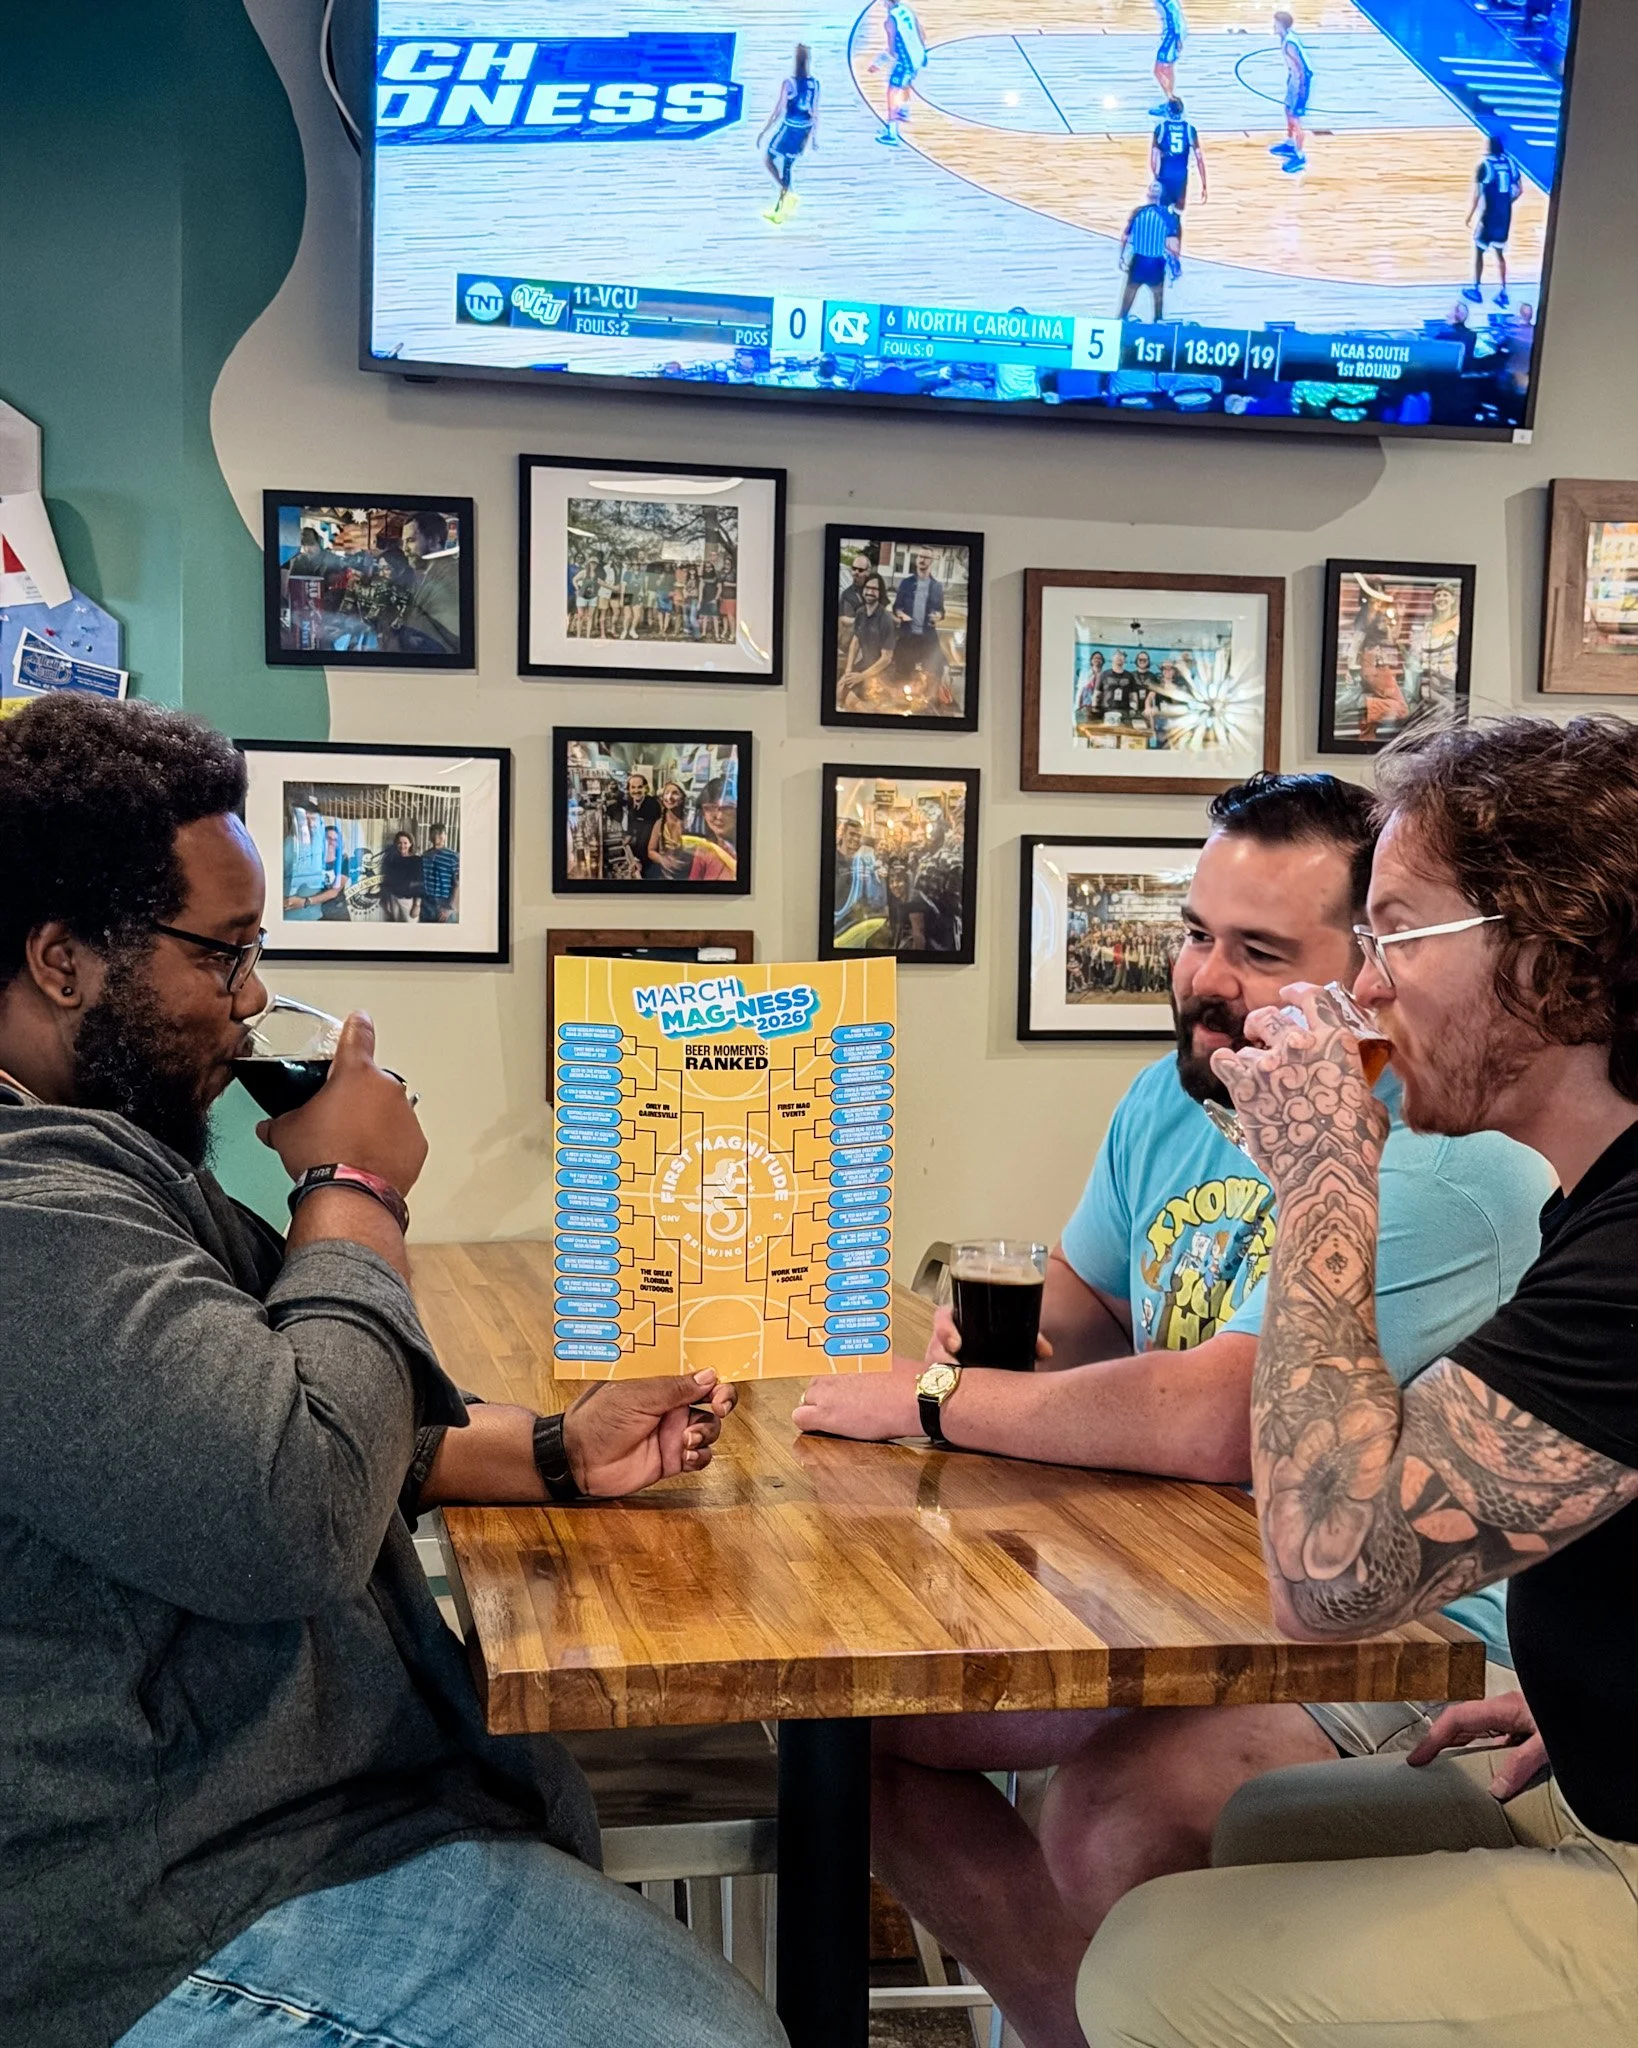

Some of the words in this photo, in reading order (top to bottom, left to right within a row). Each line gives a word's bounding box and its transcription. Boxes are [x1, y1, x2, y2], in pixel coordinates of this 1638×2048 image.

[378, 42, 539, 81] CH
[1170, 131, 1184, 154] 5
[465, 293, 504, 311] TNT
[573, 286, 639, 311] 11-VCU
[575, 317, 630, 337] FOULS:2
[789, 307, 807, 340] 0
[886, 310, 897, 327] 6
[906, 310, 968, 334] NORTH
[973, 314, 1065, 340] CAROLINA
[734, 329, 769, 346] POSS
[1087, 328, 1106, 360] 5
[883, 340, 935, 358] FOULS:0
[1134, 337, 1165, 363] 1ST
[1184, 338, 1241, 367] 18:09
[1250, 346, 1276, 370] 19
[1330, 342, 1365, 360] NCAA
[1366, 344, 1410, 362] SOUTH
[1355, 361, 1402, 380] ROUND
[636, 978, 736, 1009] MARCH
[661, 987, 811, 1031] MAG-NESS
[756, 1010, 804, 1032] 2026
[685, 1045, 710, 1057] BEER
[713, 1044, 769, 1057] MOMENTS:
[685, 1057, 769, 1071] RANKED
[638, 1110, 679, 1119] GAINESVILLE
[782, 1110, 806, 1118] EVENTS
[660, 1148, 693, 1204] FIRST
[694, 1135, 790, 1202] MAGNITUDE
[640, 1268, 652, 1276] THE
[653, 1269, 673, 1277] GREAT
[643, 1276, 670, 1285] FLORIDA
[771, 1268, 790, 1276] WORK
[791, 1266, 809, 1274] WEEK
[781, 1274, 803, 1283] SOCIAL
[639, 1284, 674, 1293] OUTDOORS
